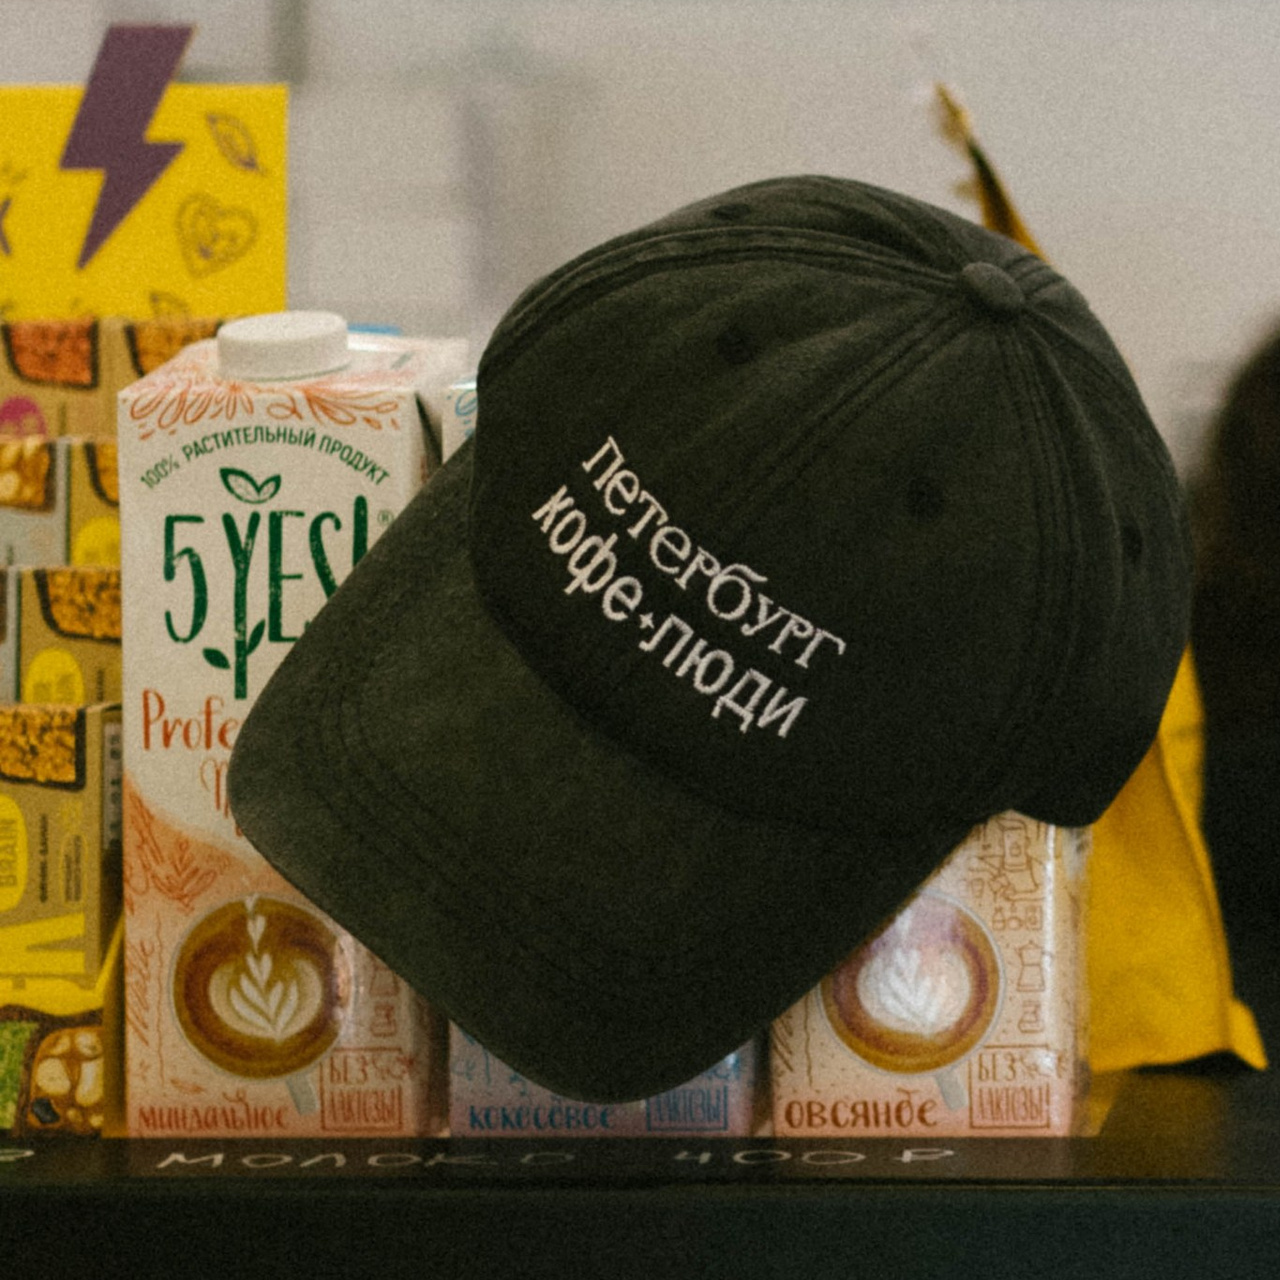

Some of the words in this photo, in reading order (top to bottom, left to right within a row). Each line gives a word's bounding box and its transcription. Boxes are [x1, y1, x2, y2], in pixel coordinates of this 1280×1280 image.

[140, 454, 180, 490] 100%
[182, 425, 316, 463] РАСТИТЕЛЬНЫЙ
[318, 434, 391, 487] ПРОДУКТ
[674, 1149, 867, 1166] 400
